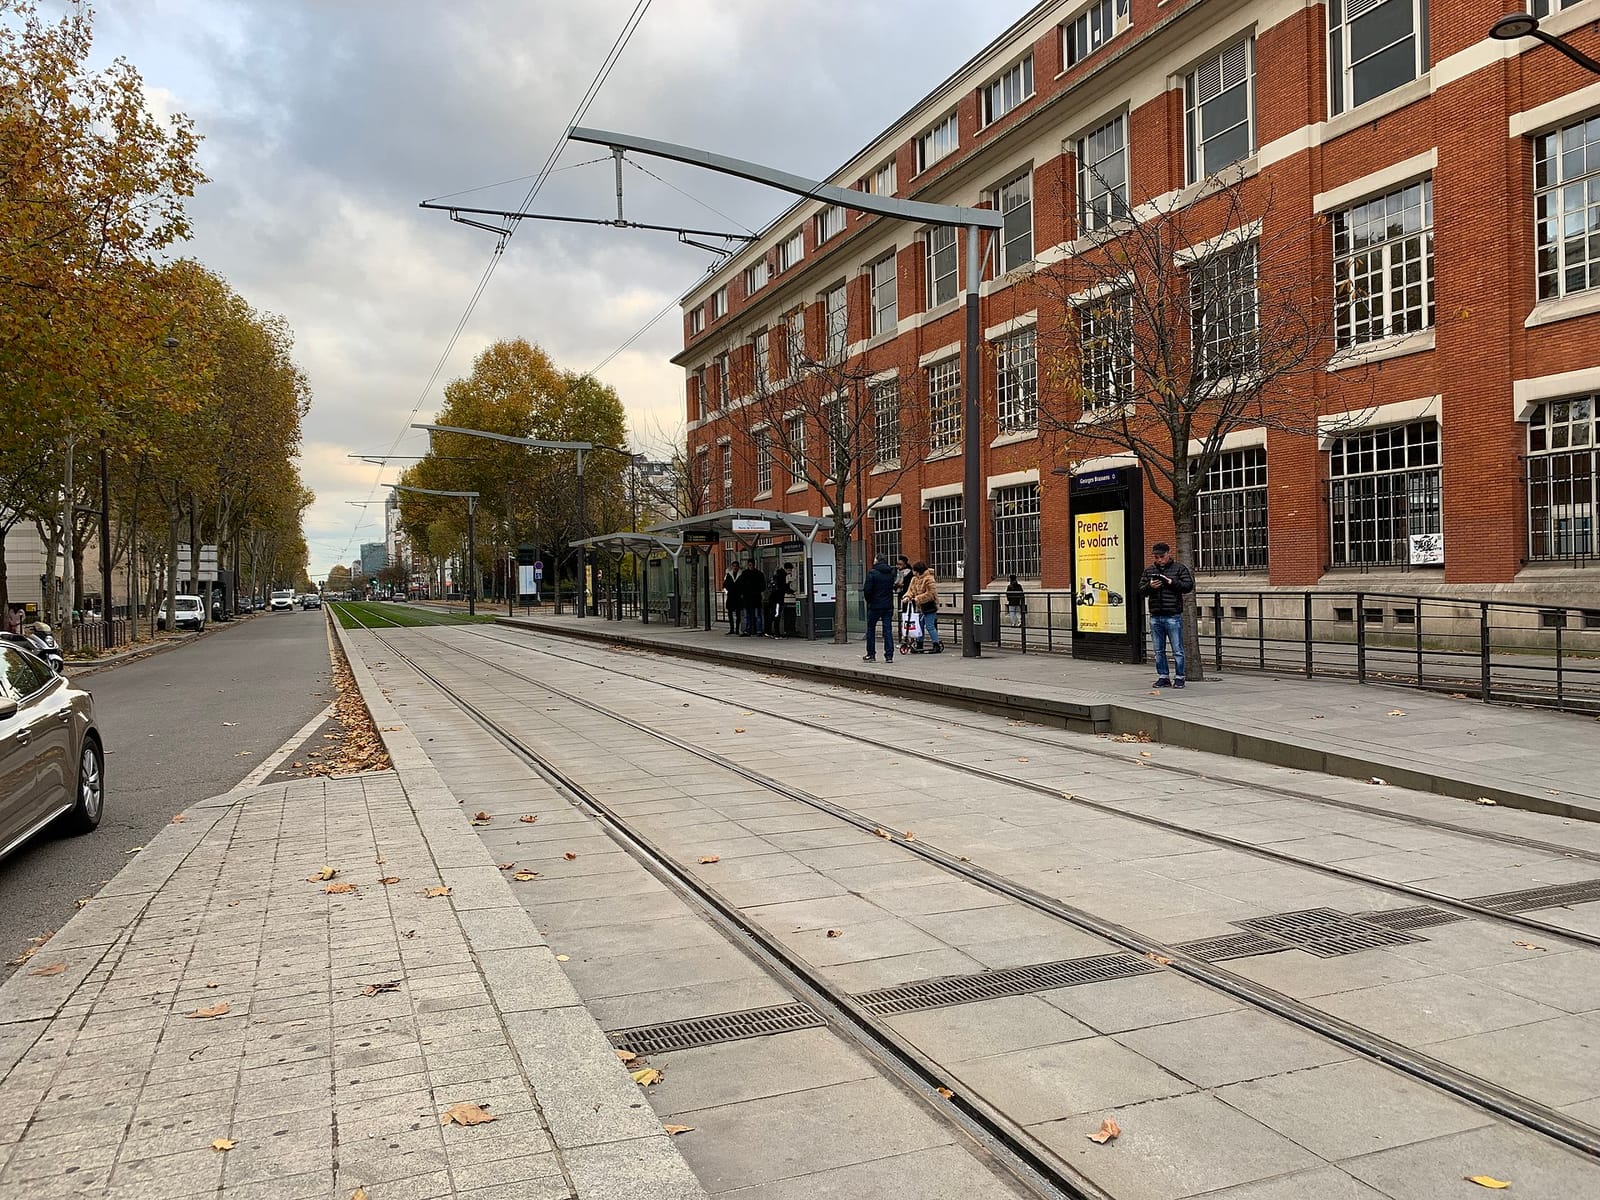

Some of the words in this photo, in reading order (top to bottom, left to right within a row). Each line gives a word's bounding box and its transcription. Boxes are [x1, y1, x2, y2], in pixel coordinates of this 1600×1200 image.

[1077, 520, 1108, 533] Prenez
[1078, 535, 1086, 549] le
[1087, 534, 1119, 548] volant
